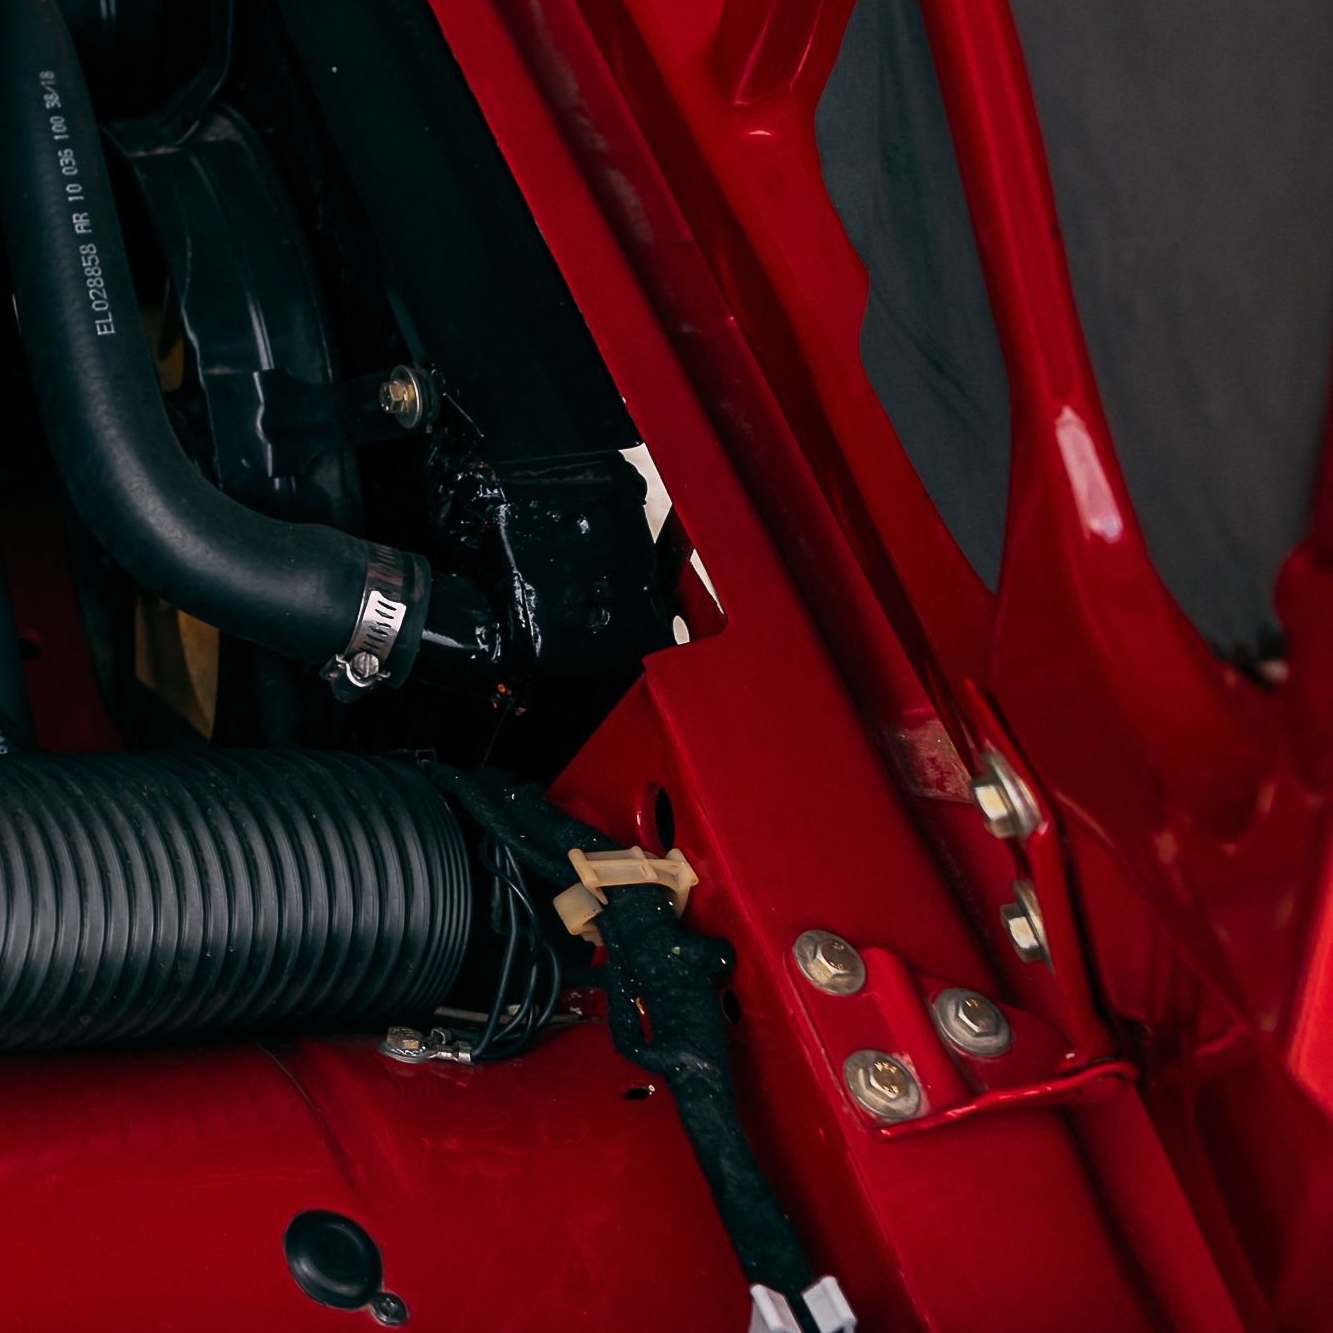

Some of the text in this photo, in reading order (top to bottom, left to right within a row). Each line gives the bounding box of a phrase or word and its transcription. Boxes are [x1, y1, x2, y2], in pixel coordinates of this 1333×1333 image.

[50, 116, 69, 140] 100
[66, 183, 84, 202] 10
[72, 212, 92, 234] AR
[79, 243, 115, 336] EL028858
